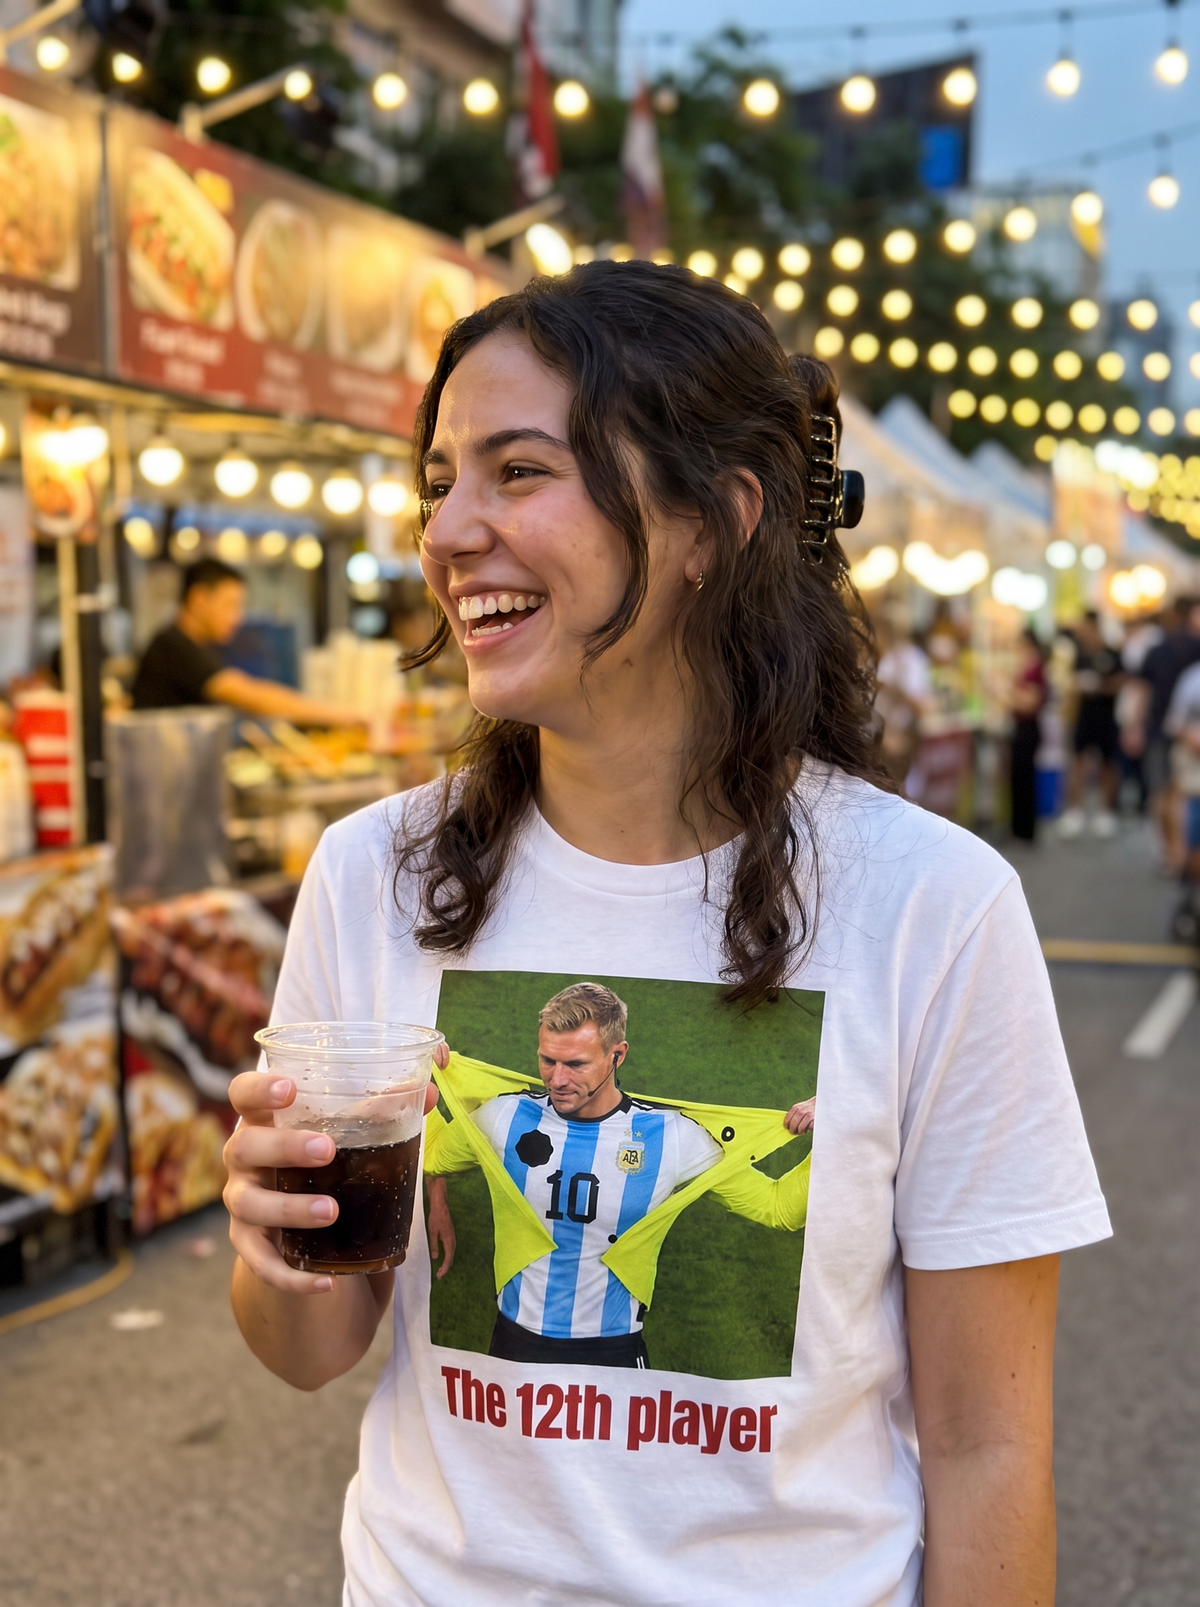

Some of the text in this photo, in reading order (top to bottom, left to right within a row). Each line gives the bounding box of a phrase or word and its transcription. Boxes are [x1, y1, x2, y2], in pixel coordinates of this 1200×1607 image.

[545, 1169, 600, 1224] 10
[440, 1366, 778, 1455] The 12th player
